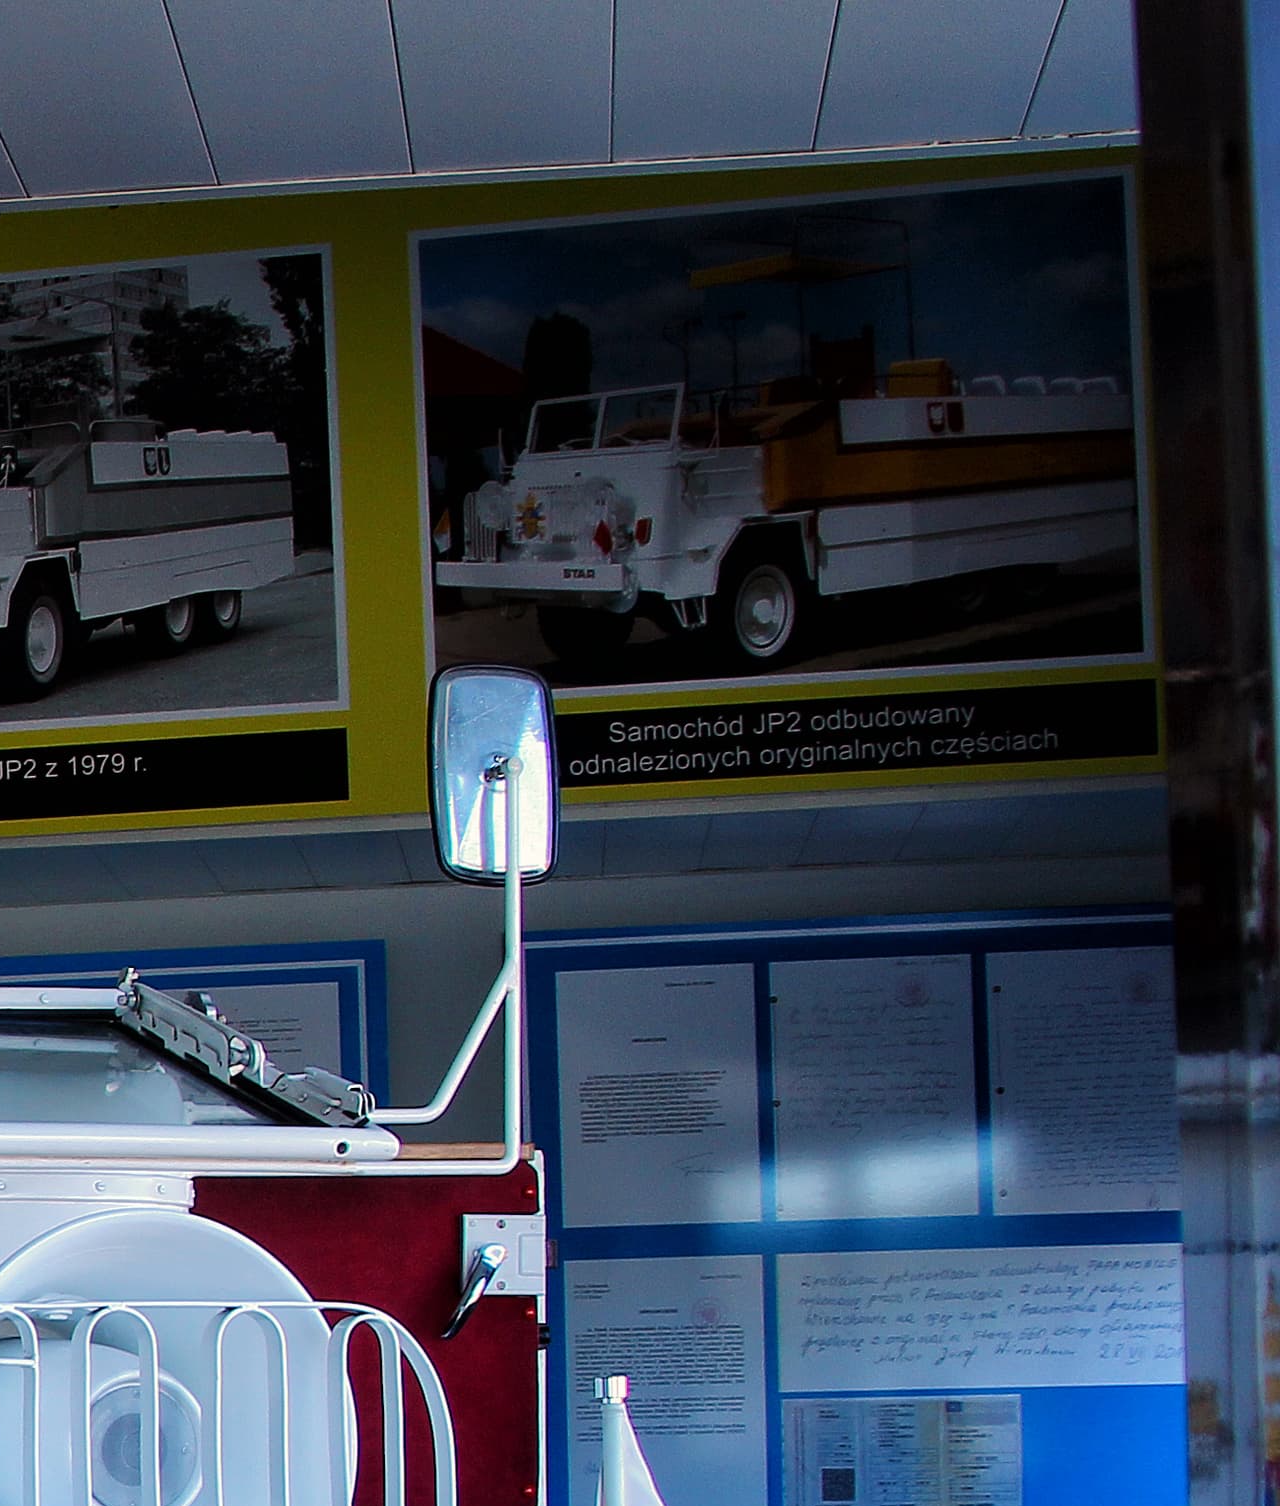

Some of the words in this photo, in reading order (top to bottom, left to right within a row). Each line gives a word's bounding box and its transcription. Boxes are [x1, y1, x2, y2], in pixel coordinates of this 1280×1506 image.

[562, 567, 597, 579] STAR
[608, 713, 744, 743] Samochód
[752, 710, 802, 735] JP2
[810, 703, 976, 732] odbudowany
[45, 760, 59, 778] z
[67, 753, 126, 776] 1979
[133, 756, 148, 773] r.
[568, 744, 751, 777] odnalezionych
[759, 735, 922, 770] oryginalnych
[930, 728, 1059, 757] częściach
